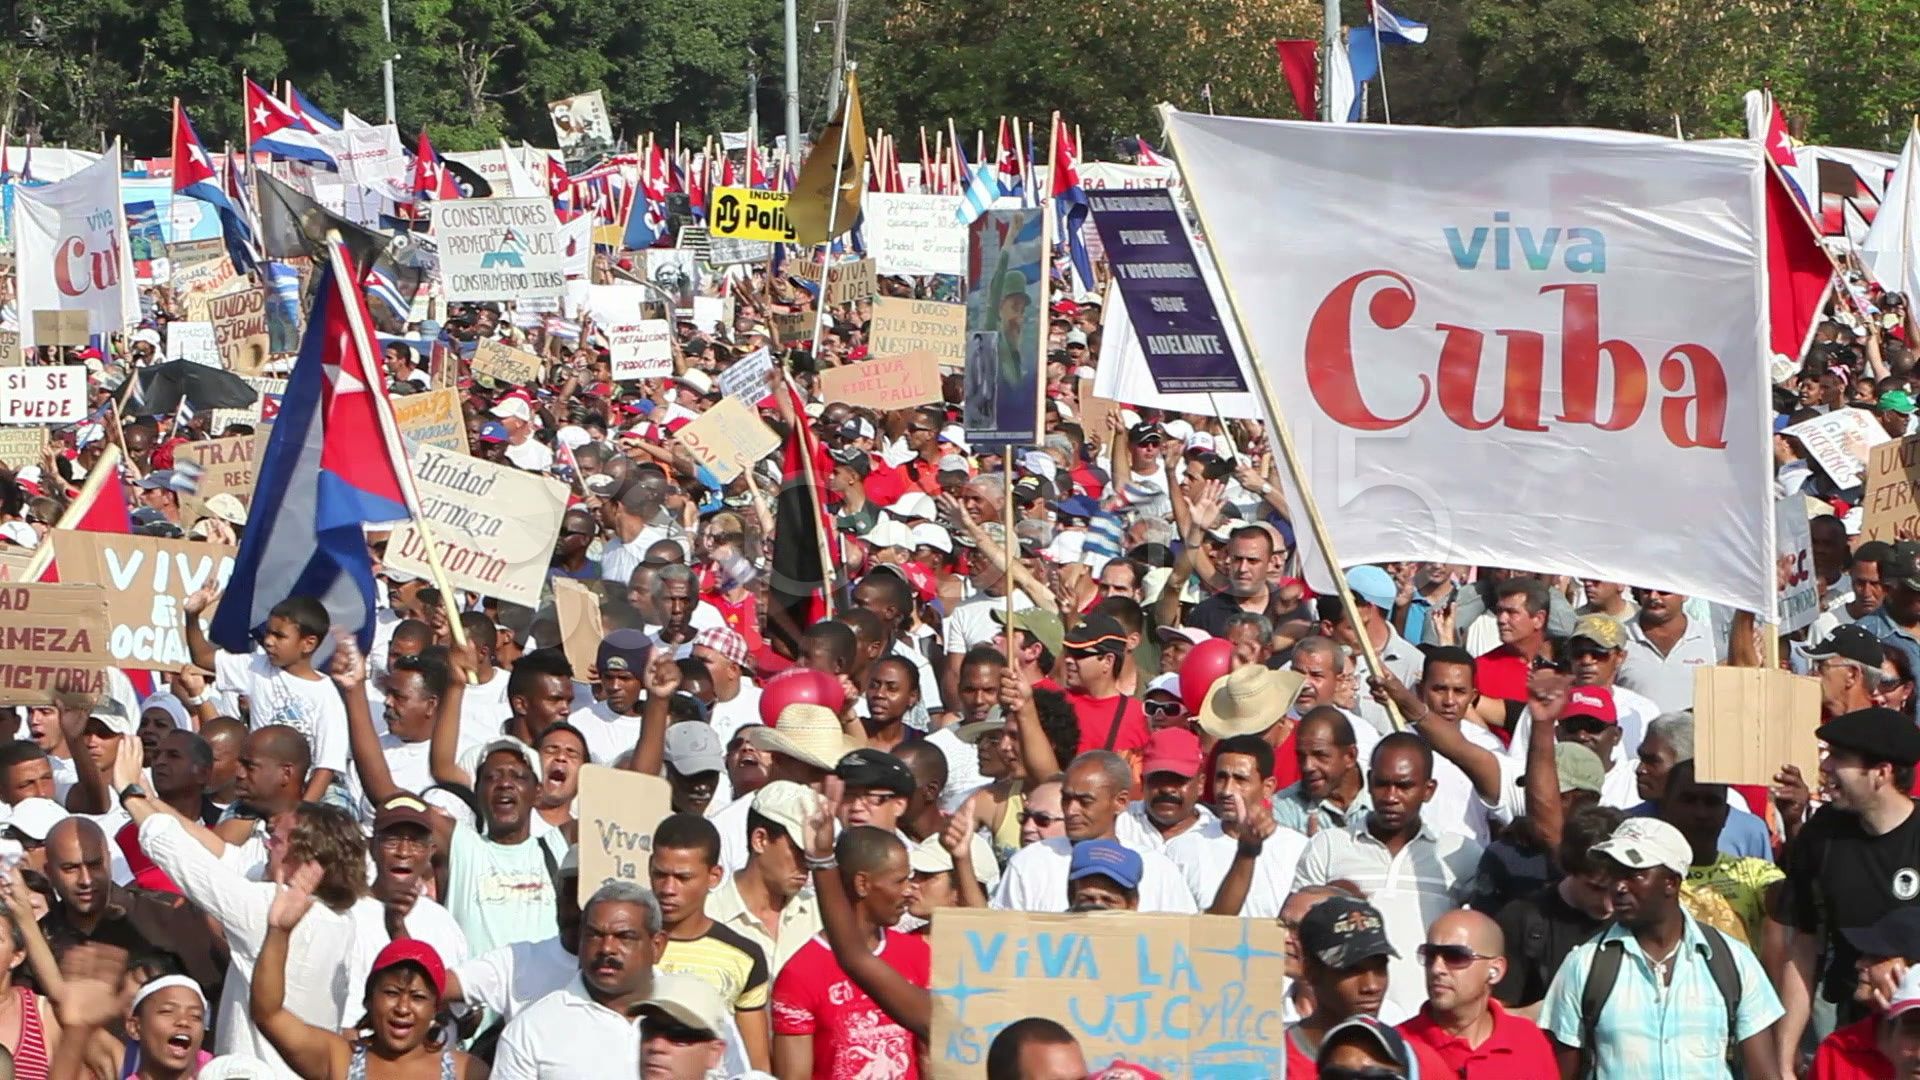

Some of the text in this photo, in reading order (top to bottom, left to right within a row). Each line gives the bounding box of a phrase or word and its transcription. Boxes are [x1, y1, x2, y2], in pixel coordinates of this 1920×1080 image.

[86, 207, 114, 232] viva
[441, 205, 547, 228] CONSTRUCTORES
[1442, 211, 1607, 274] viva
[532, 272, 563, 288] IDEAS
[1151, 297, 1188, 312] SIGUE
[1146, 335, 1224, 355] ADELANTE
[1304, 268, 1727, 450] Cuba
[46, 373, 67, 389] SE
[10, 399, 71, 417] PUEDE
[418, 451, 499, 497] Unidad
[595, 818, 652, 855] Viva
[614, 855, 636, 879] la
[1136, 933, 1203, 992] LA
